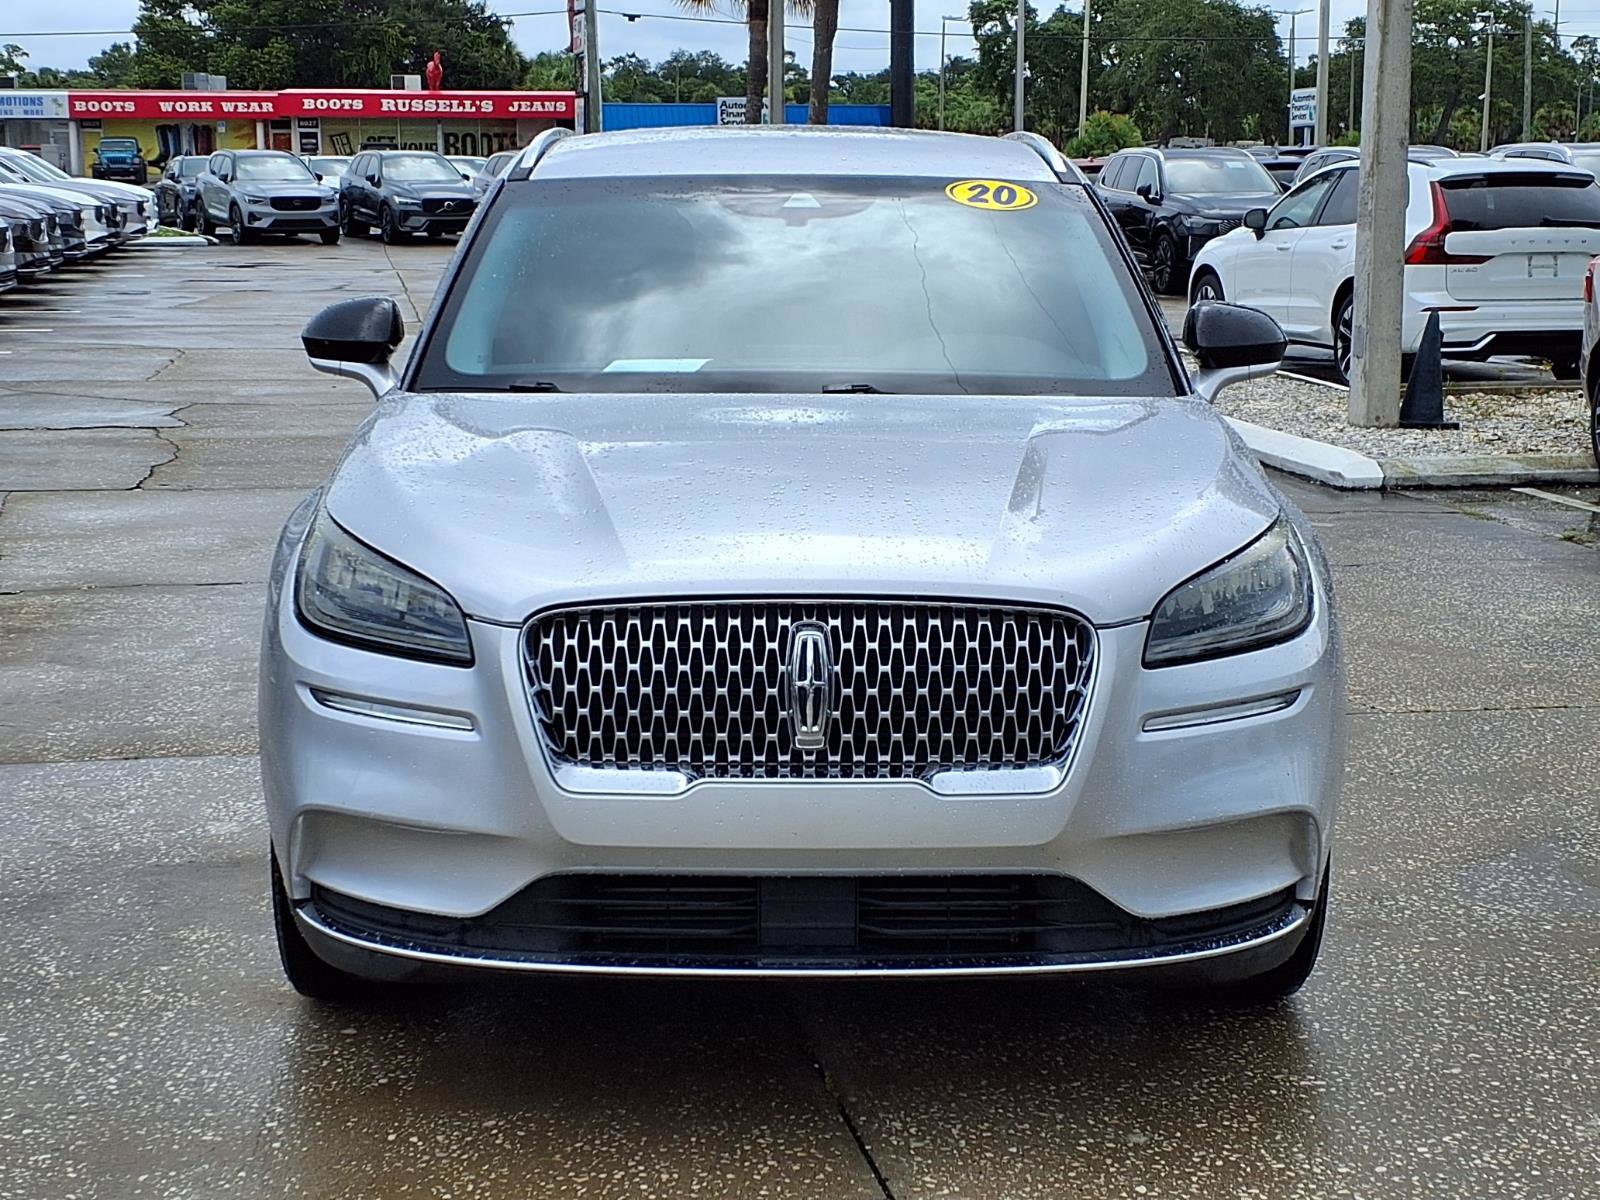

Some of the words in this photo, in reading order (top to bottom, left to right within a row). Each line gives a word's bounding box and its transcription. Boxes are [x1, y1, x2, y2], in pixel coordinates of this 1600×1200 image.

[74, 101, 136, 112] BOOTS
[158, 101, 213, 112] WORK
[220, 101, 274, 112] WEAR
[302, 98, 363, 110] BOOTS
[380, 99, 494, 112] RUSSELL'S
[508, 101, 567, 112] JEANS
[967, 184, 1017, 205] 20
